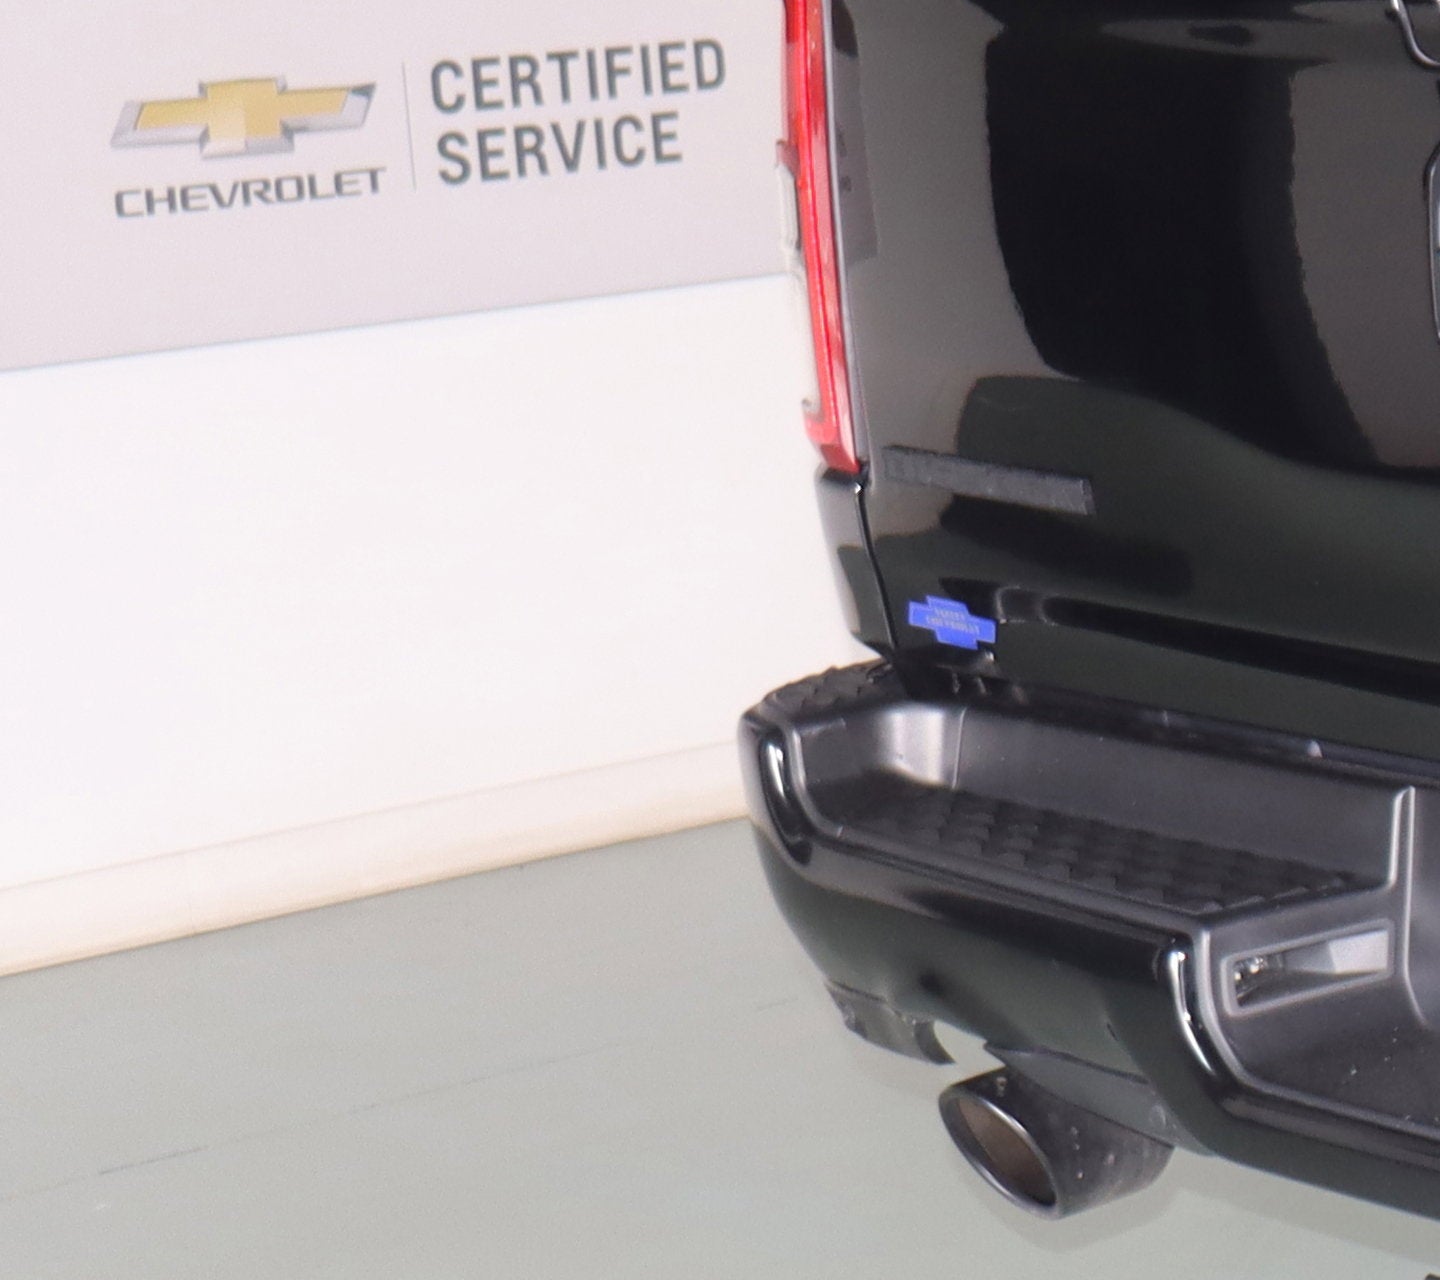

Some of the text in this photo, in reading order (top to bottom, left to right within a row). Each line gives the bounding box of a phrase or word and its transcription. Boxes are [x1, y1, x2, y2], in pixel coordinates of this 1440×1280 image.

[430, 37, 727, 115] CERTIFIED
[436, 110, 683, 187] SERVICE
[114, 166, 387, 219] CHEVROLET
